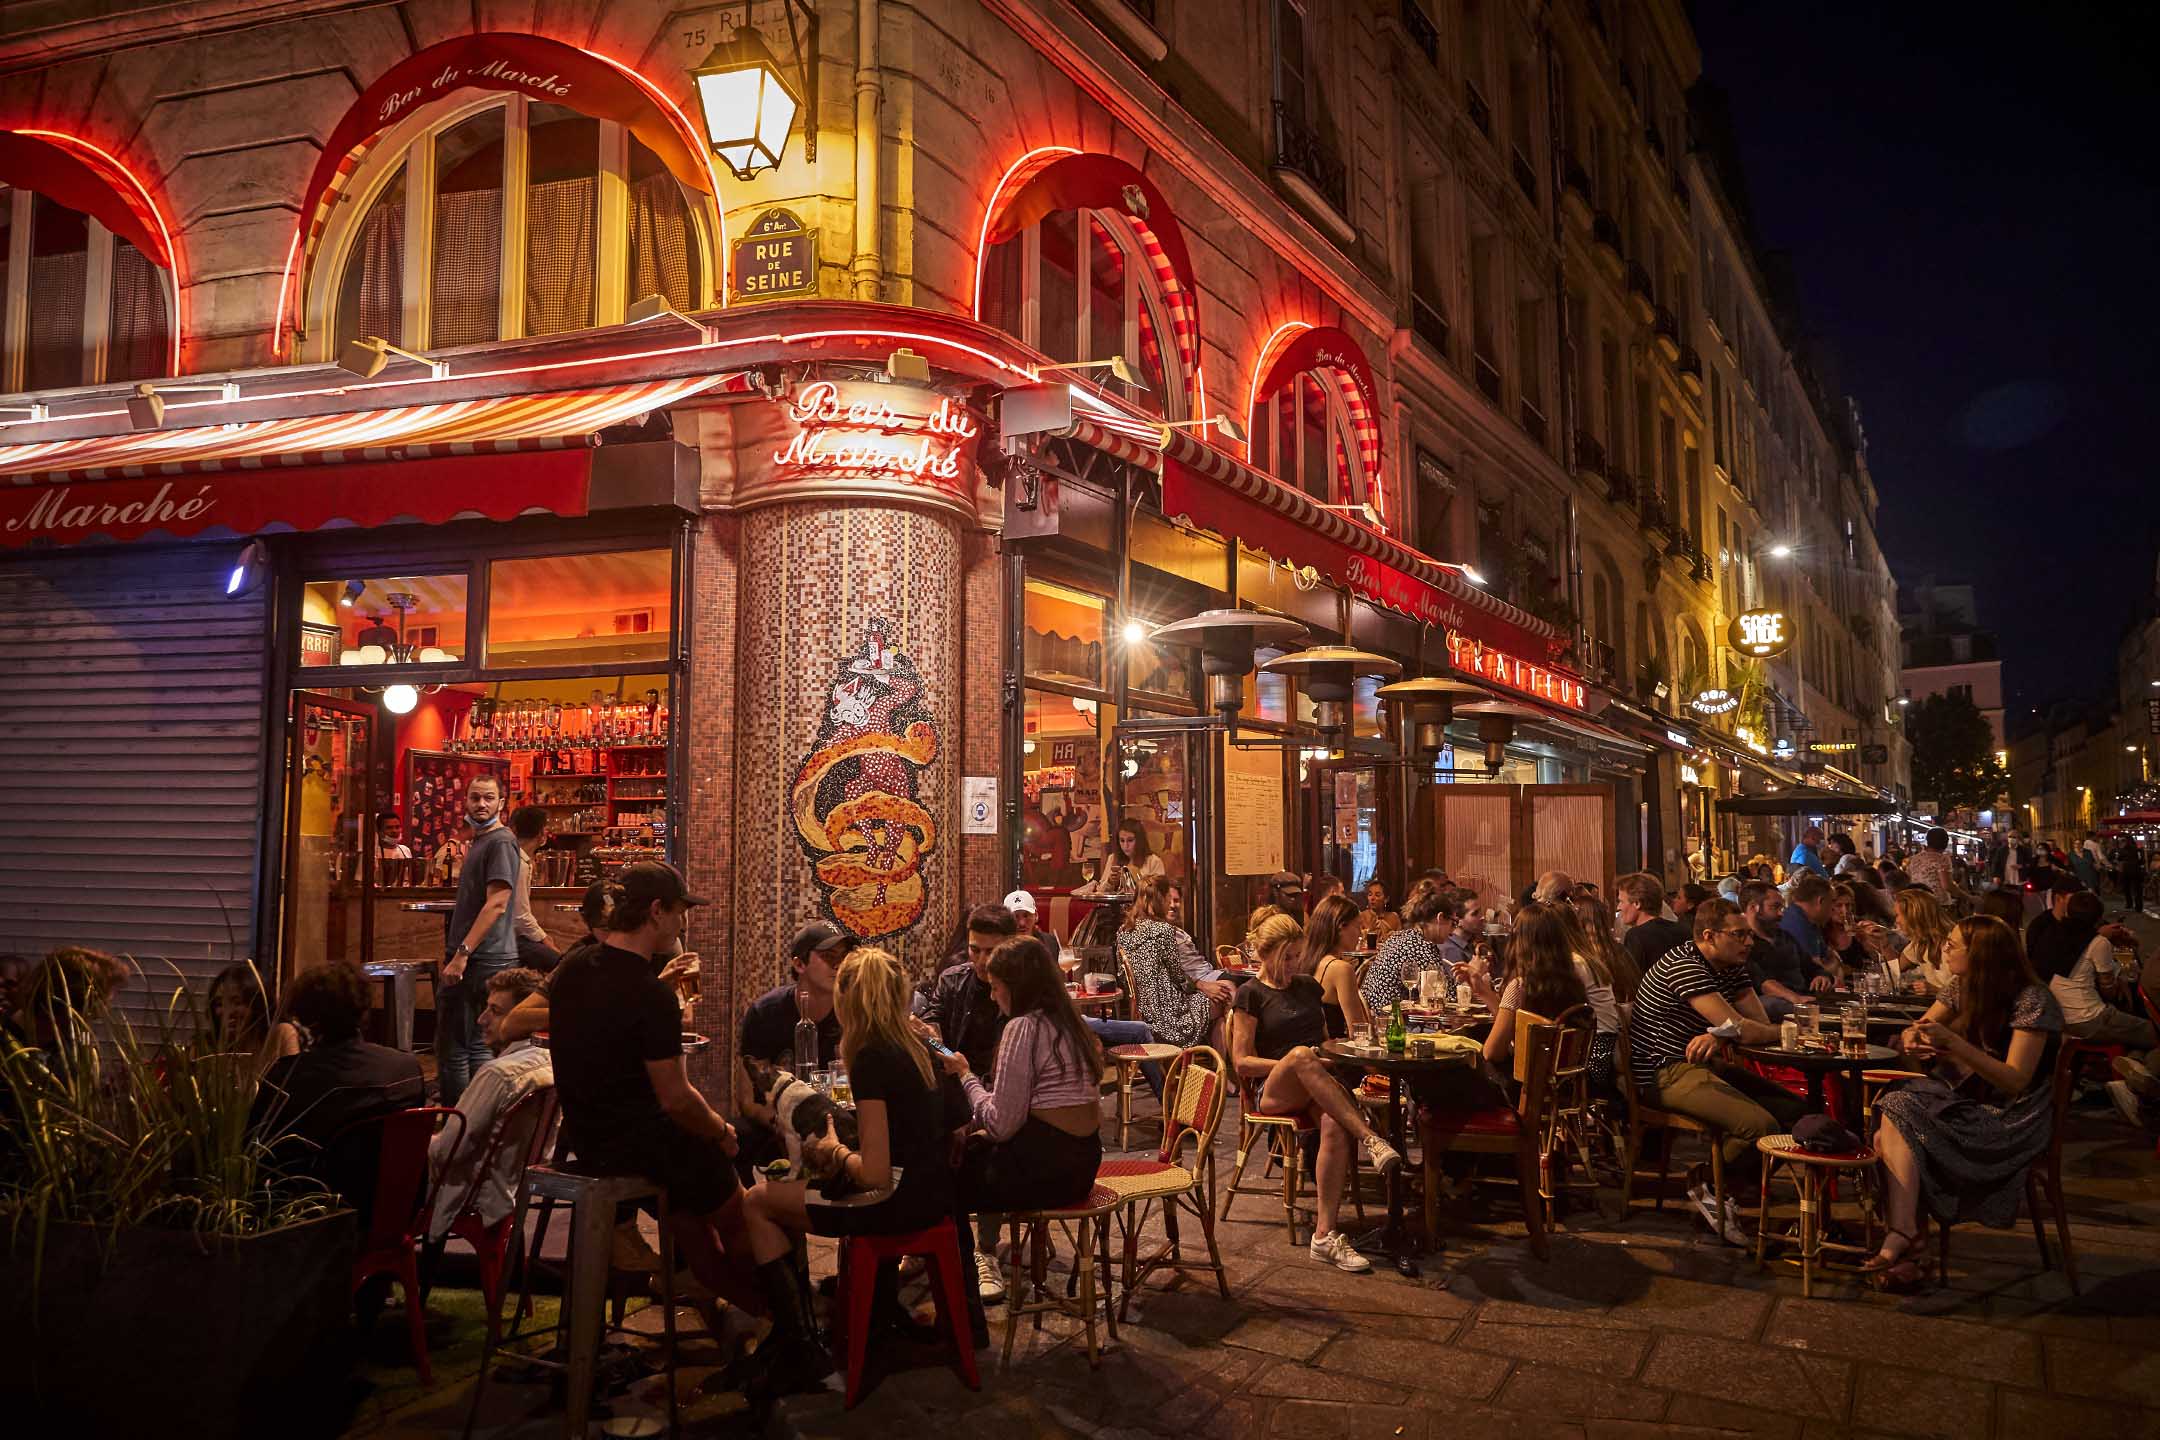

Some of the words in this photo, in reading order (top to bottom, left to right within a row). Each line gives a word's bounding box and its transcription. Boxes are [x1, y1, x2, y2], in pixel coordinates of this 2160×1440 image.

[683, 30, 706, 48] 75
[379, 86, 423, 121] Bar
[431, 65, 460, 89] du
[467, 59, 573, 97] Marché
[756, 241, 793, 261] RUE
[767, 261, 780, 271] DE
[745, 270, 803, 292] SEINE
[790, 381, 903, 428] Bar
[928, 397, 977, 438] du
[773, 428, 961, 478] Marché
[6, 482, 217, 532] Marché
[1346, 555, 1380, 593] Bar
[1389, 577, 1408, 604] du
[1414, 590, 1464, 628] Marché
[1449, 636, 1584, 708] TRAITEUR
